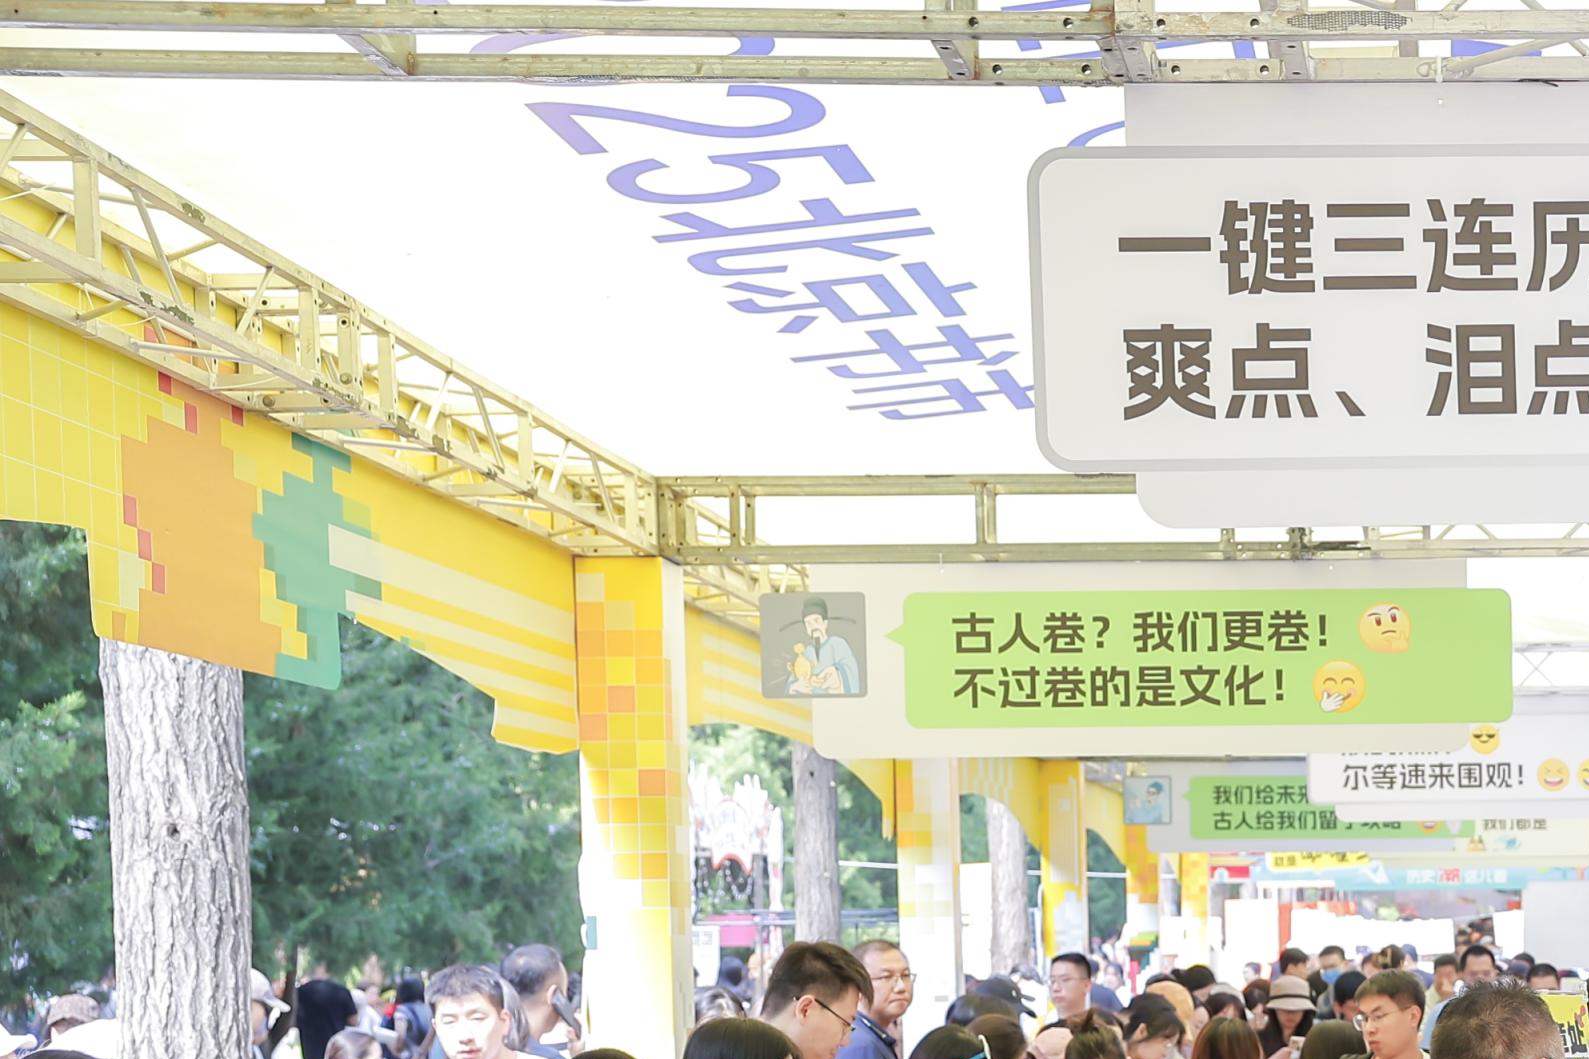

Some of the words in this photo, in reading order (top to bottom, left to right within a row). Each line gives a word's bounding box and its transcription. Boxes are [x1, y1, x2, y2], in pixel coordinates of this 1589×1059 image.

[952, 609, 1330, 656] 古人卷？我们更卷！
[952, 665, 1287, 710] 不过卷的是文化！
[1342, 762, 1525, 791] 尔等速来围观！
